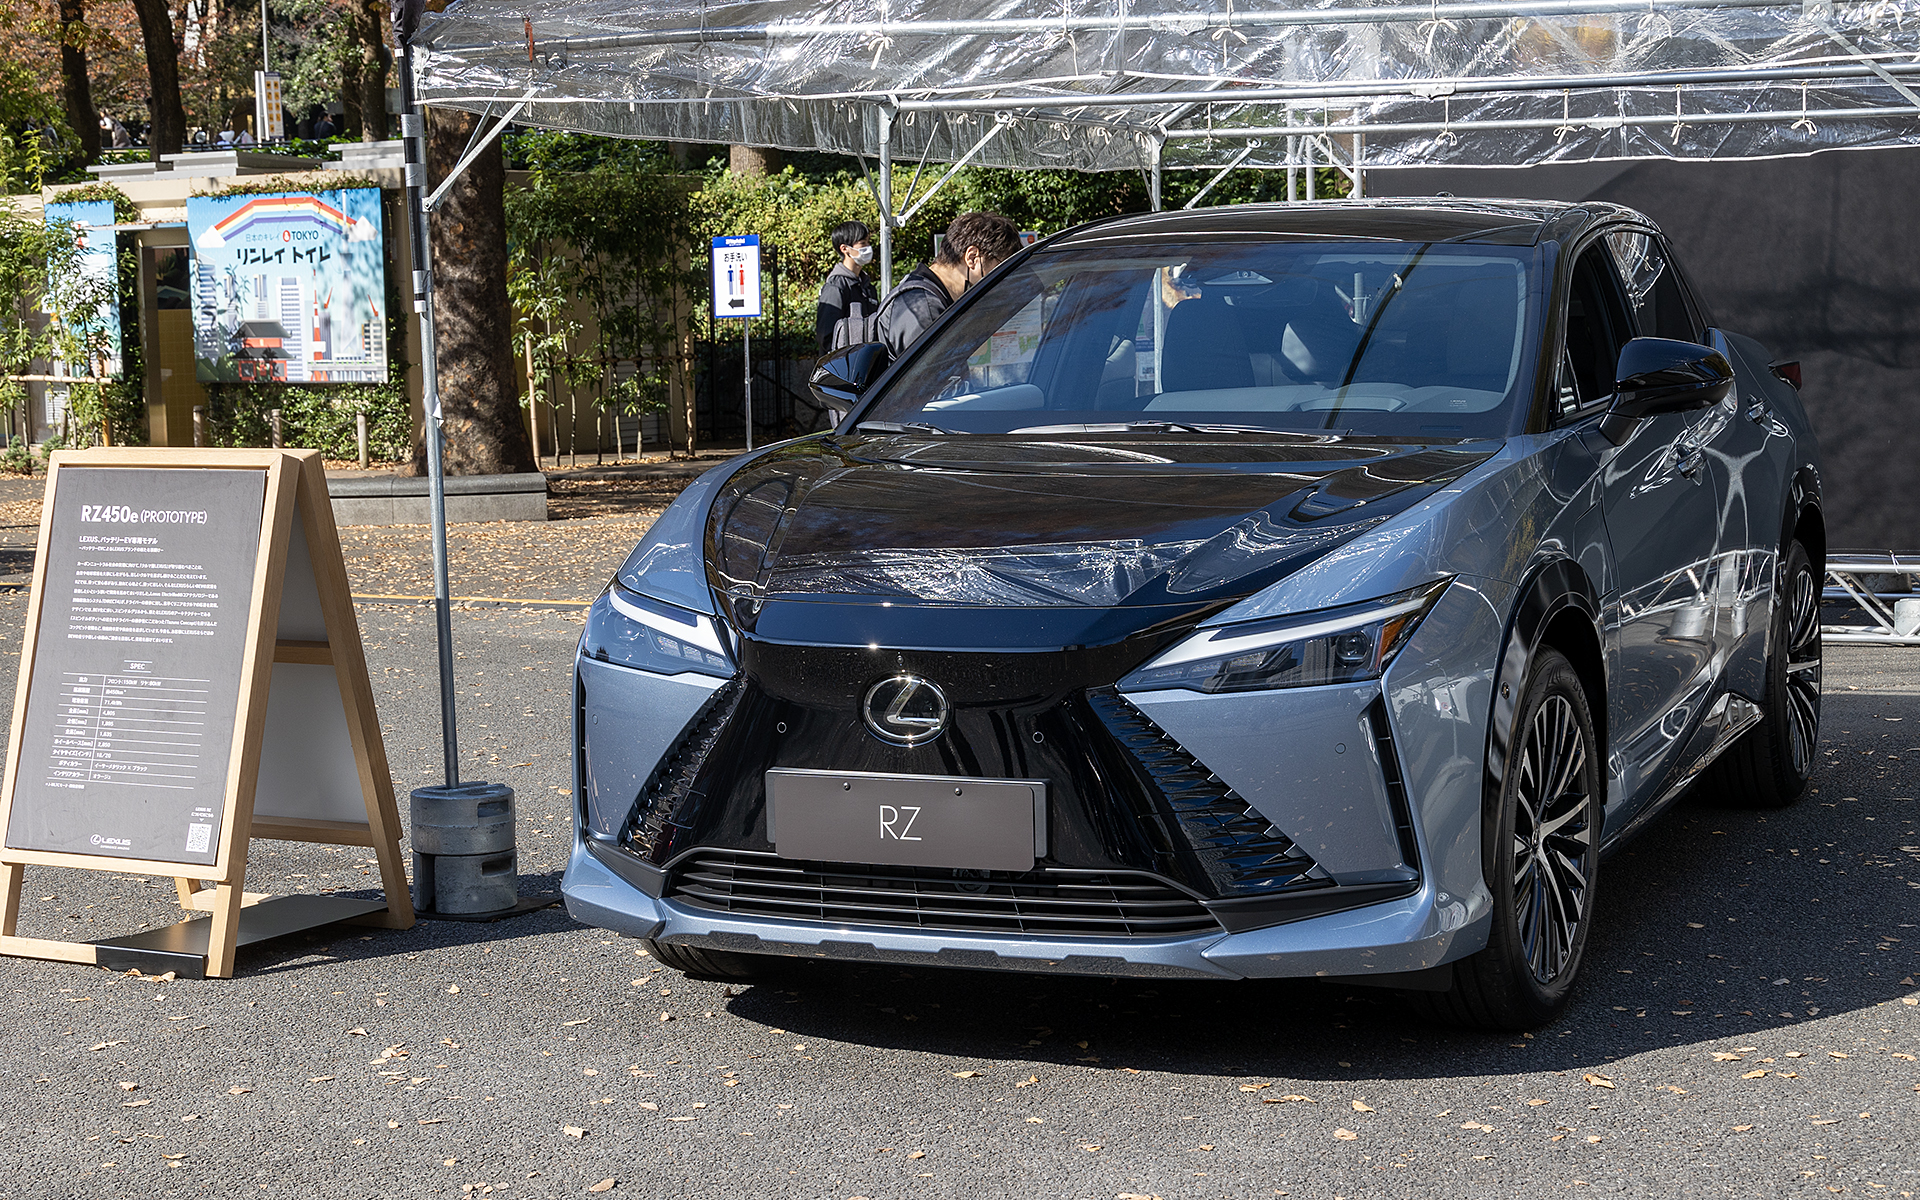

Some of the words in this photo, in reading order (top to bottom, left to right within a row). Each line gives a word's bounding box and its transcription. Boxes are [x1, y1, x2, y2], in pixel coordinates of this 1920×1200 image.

[291, 230, 319, 240] TOKYO
[237, 247, 285, 265] リンレイ
[292, 246, 331, 264] トイレ
[724, 252, 748, 263] お手洗い
[80, 504, 139, 523] RZ450e
[140, 508, 208, 525] (PROTOTYPE)
[129, 662, 146, 670] SPEC
[879, 804, 922, 841] RZ
[101, 837, 132, 845] LEXUS
